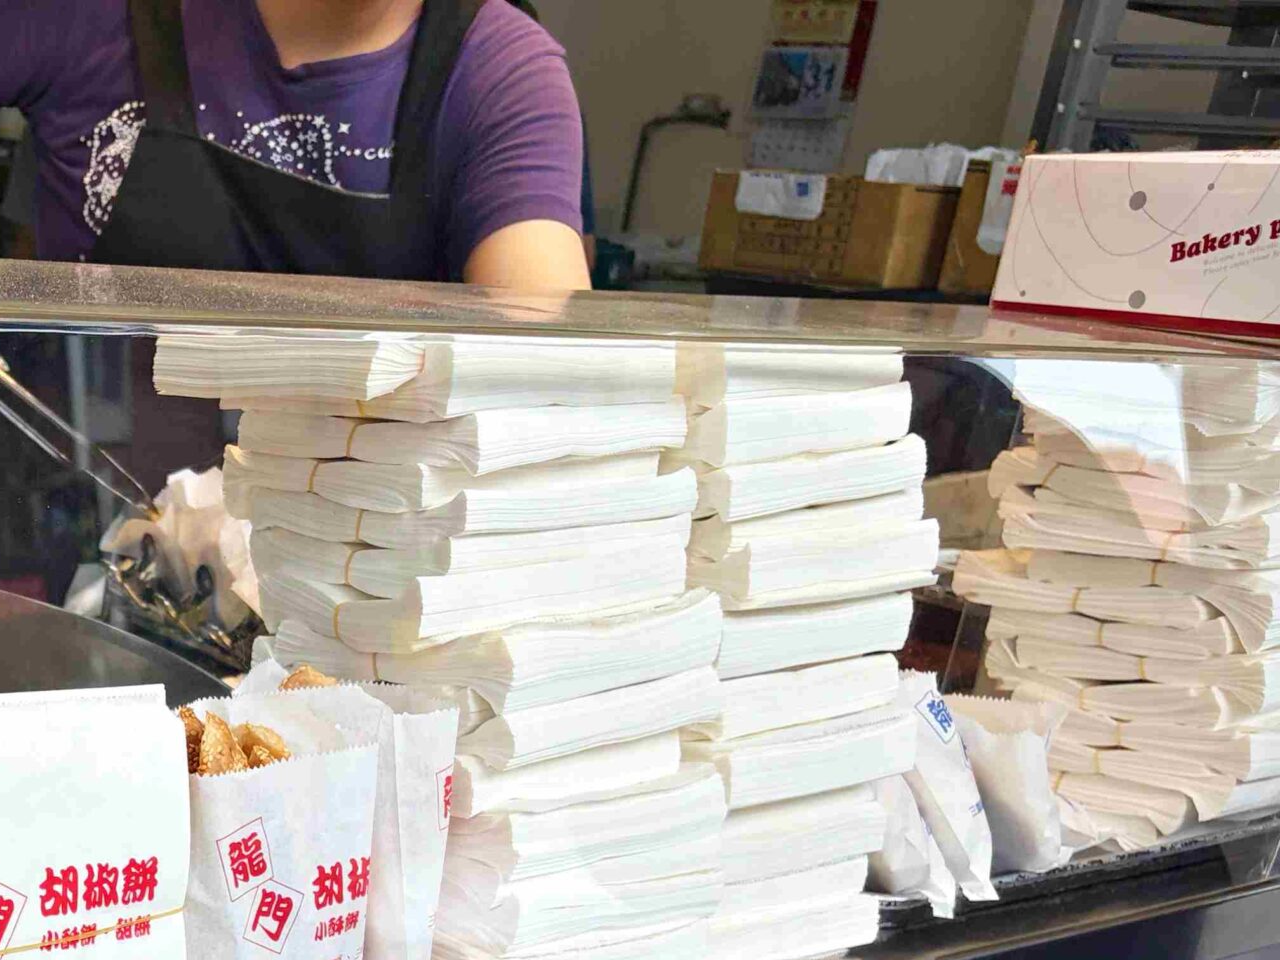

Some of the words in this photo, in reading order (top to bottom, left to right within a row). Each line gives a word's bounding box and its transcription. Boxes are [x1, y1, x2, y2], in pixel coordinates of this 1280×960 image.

[1170, 224, 1261, 263] Bakery
[39, 856, 159, 918] 胡椒餅
